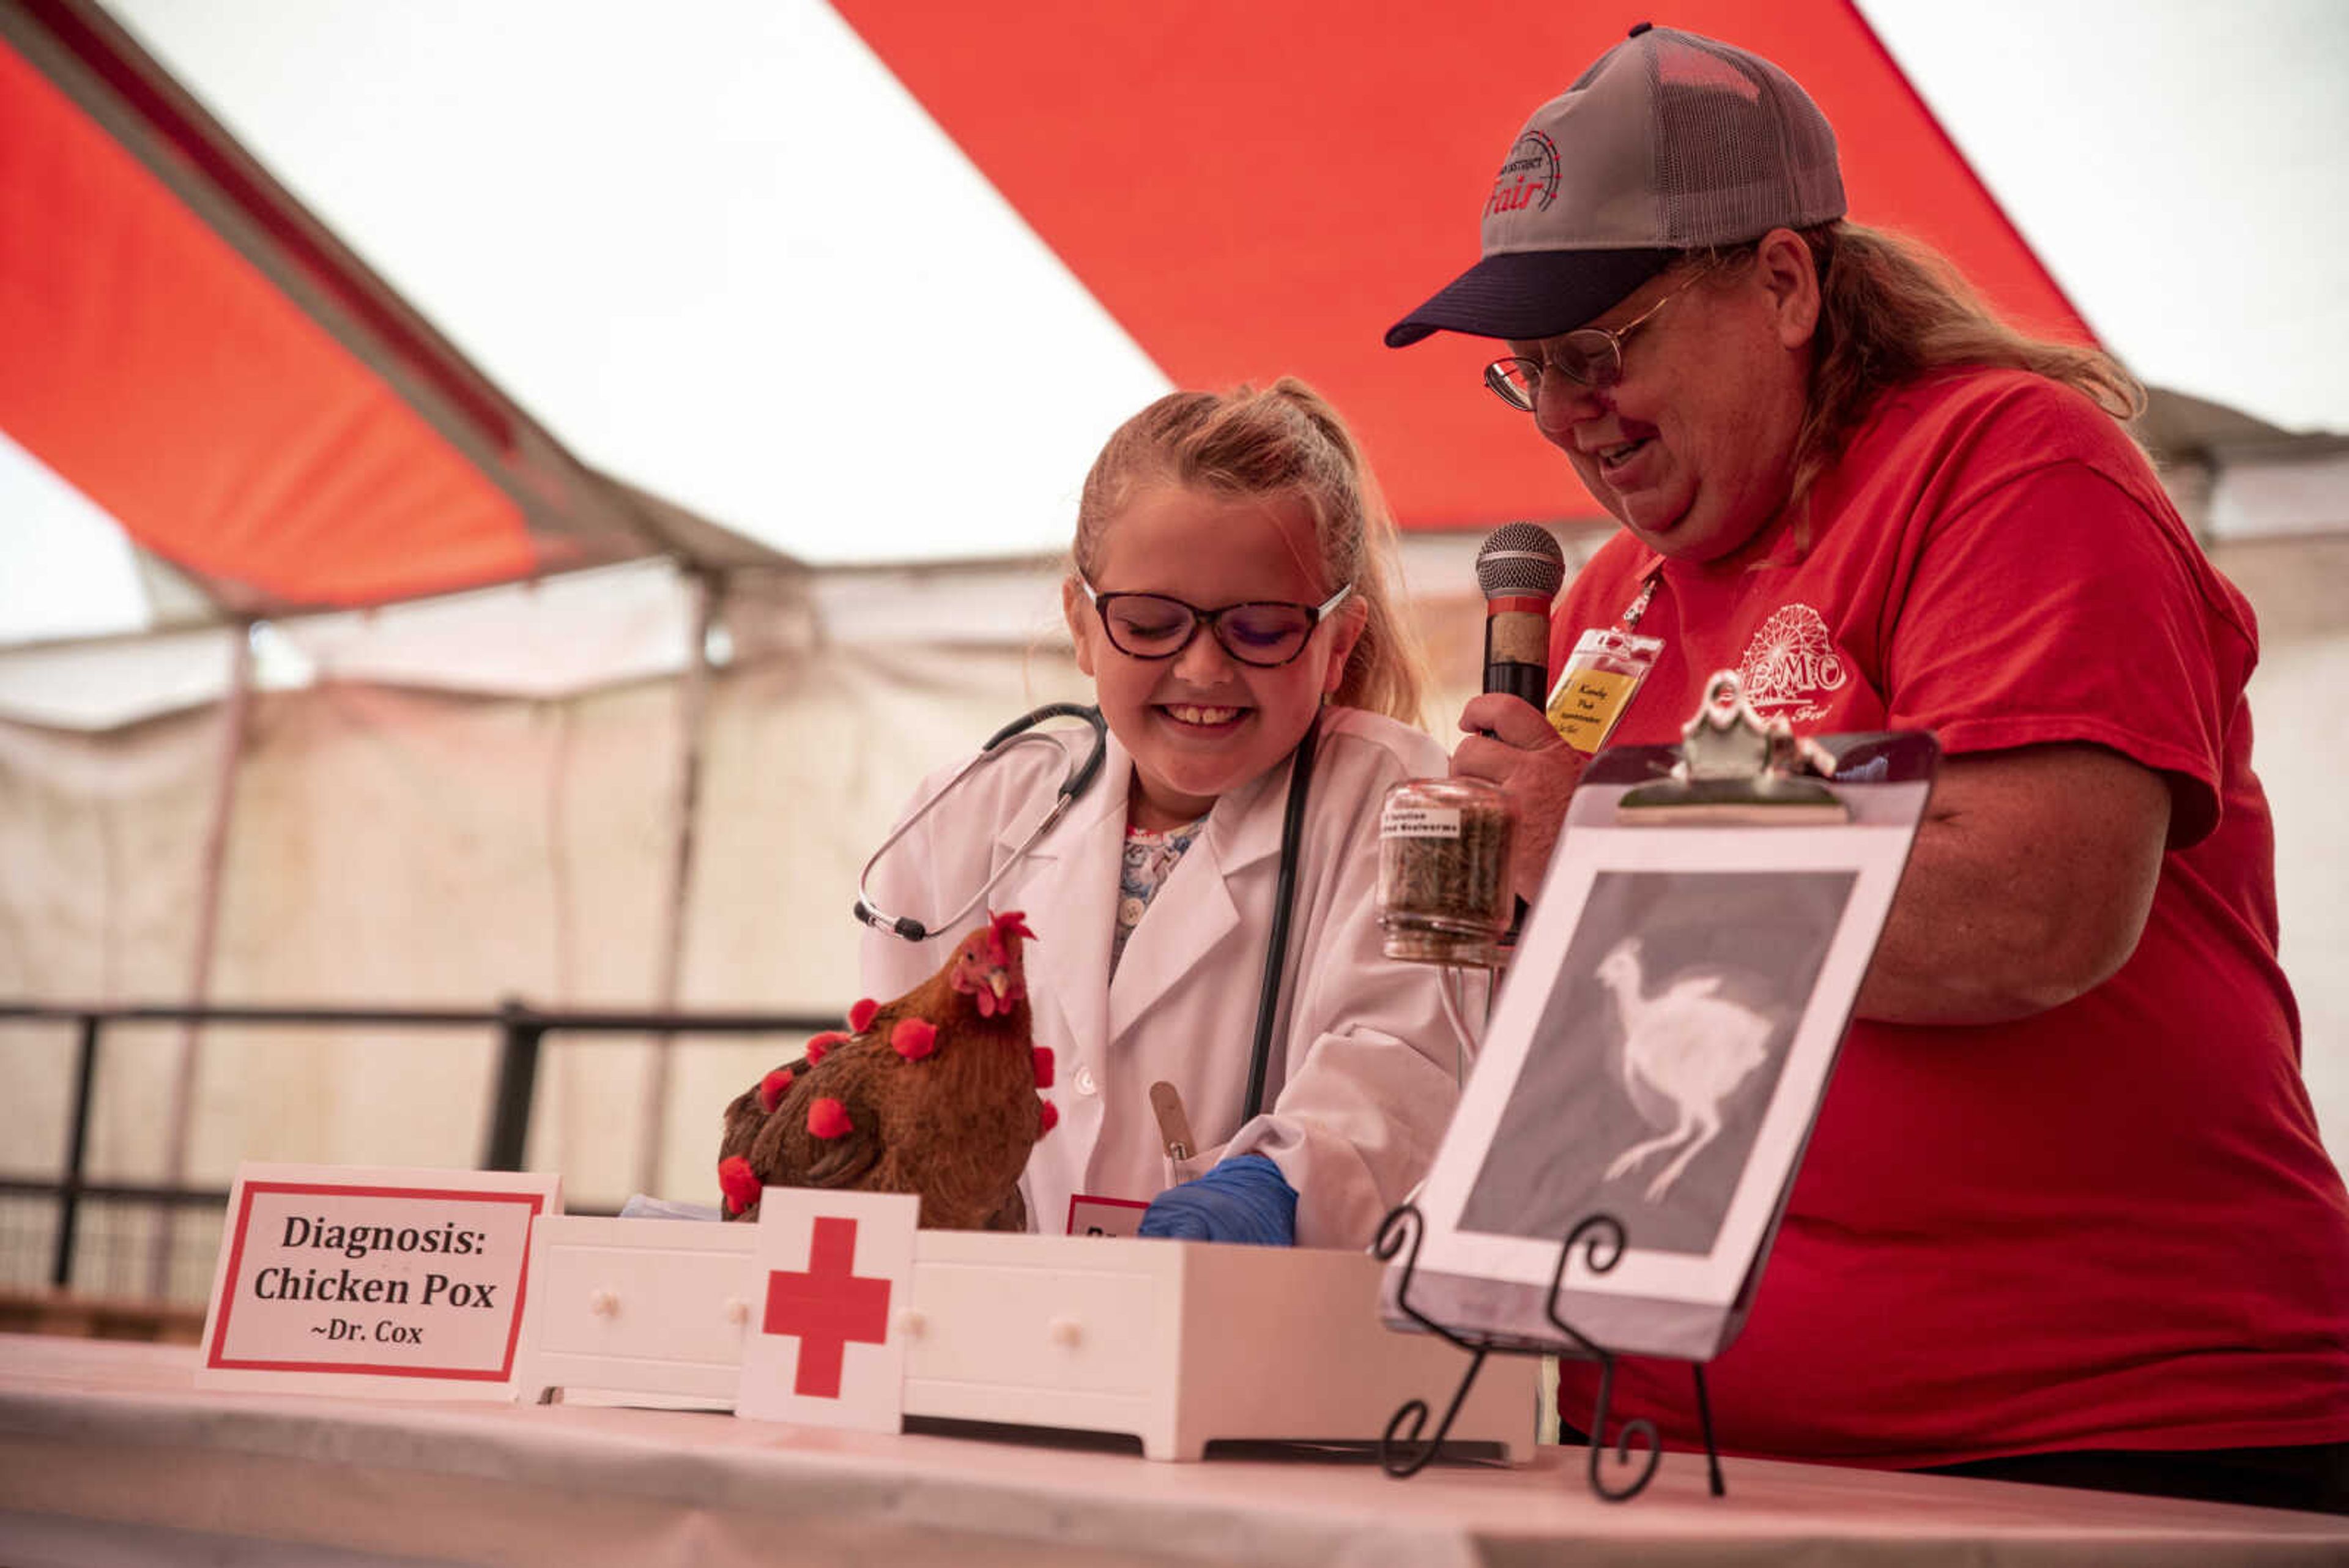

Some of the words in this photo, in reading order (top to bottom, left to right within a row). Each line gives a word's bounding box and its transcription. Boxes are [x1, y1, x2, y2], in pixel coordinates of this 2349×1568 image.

[282, 1216, 486, 1258] Diagnosis:
[254, 1268, 409, 1304] Chicken
[420, 1274, 497, 1309] Pox
[311, 1318, 365, 1341] ~Dr.
[374, 1320, 424, 1344] Cox
